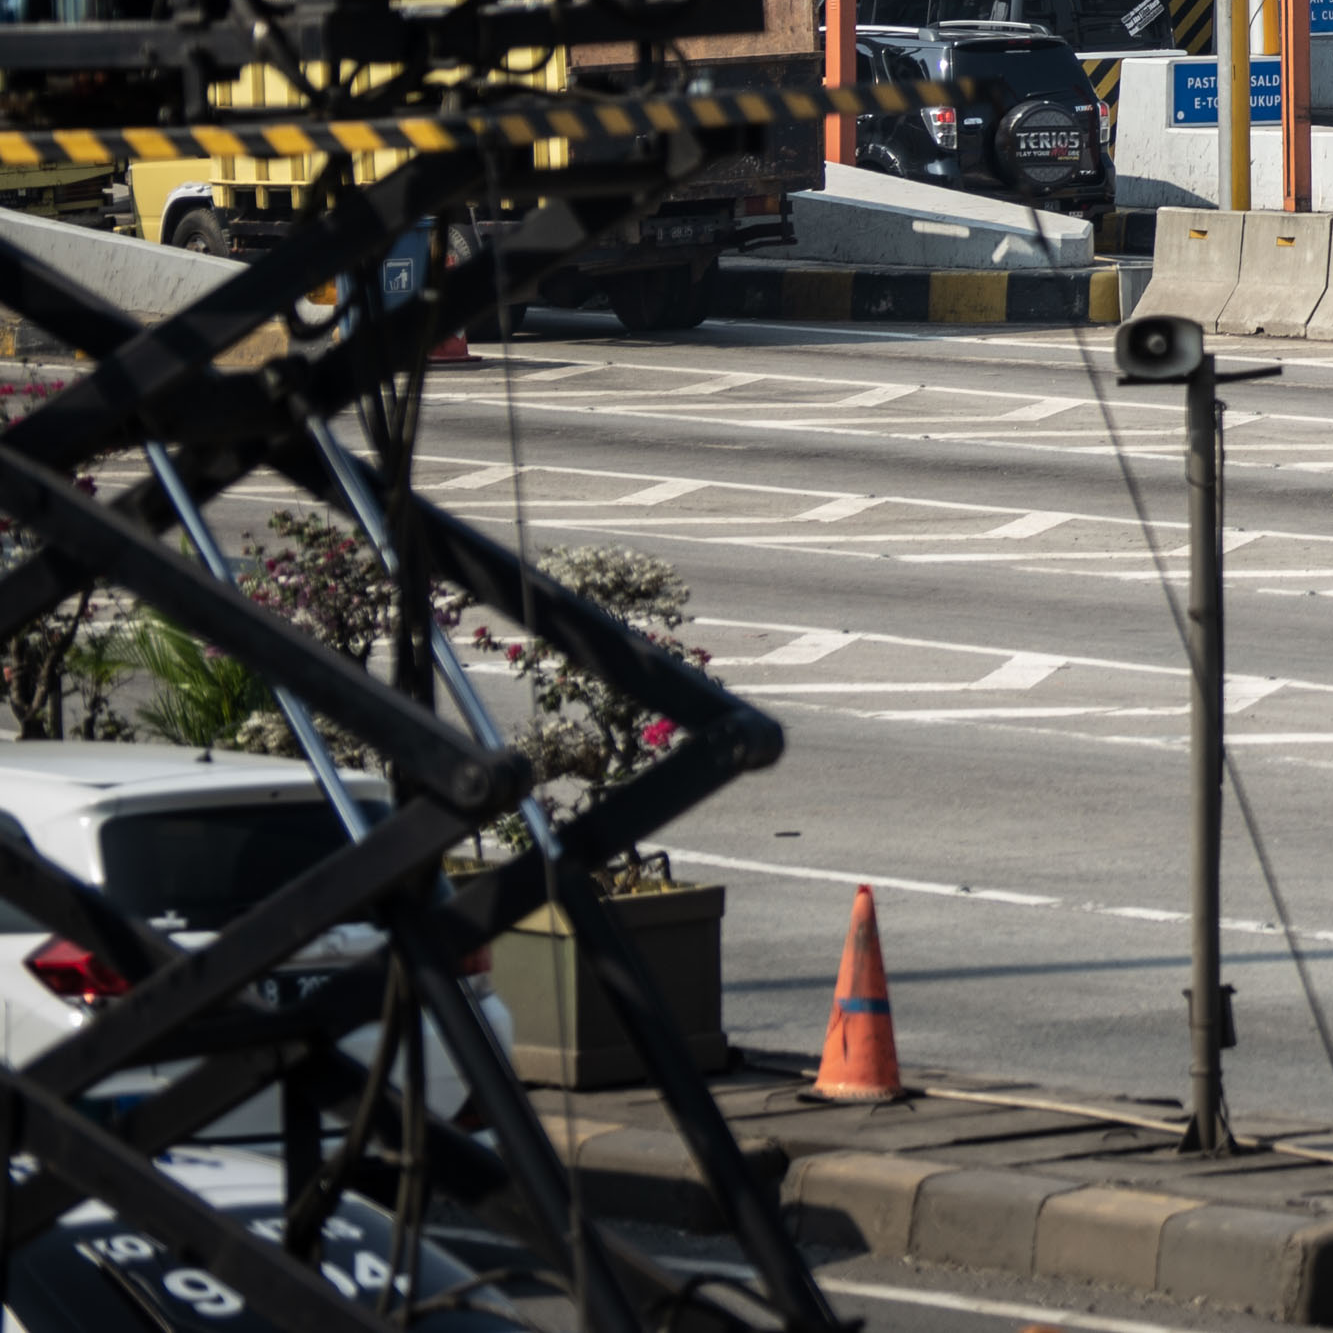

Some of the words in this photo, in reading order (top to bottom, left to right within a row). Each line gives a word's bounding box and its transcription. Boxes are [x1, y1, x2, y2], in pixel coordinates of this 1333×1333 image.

[1250, 74, 1280, 87] SALD
[1250, 96, 1281, 107] UKUP
[1016, 132, 1080, 149] TERIOS
